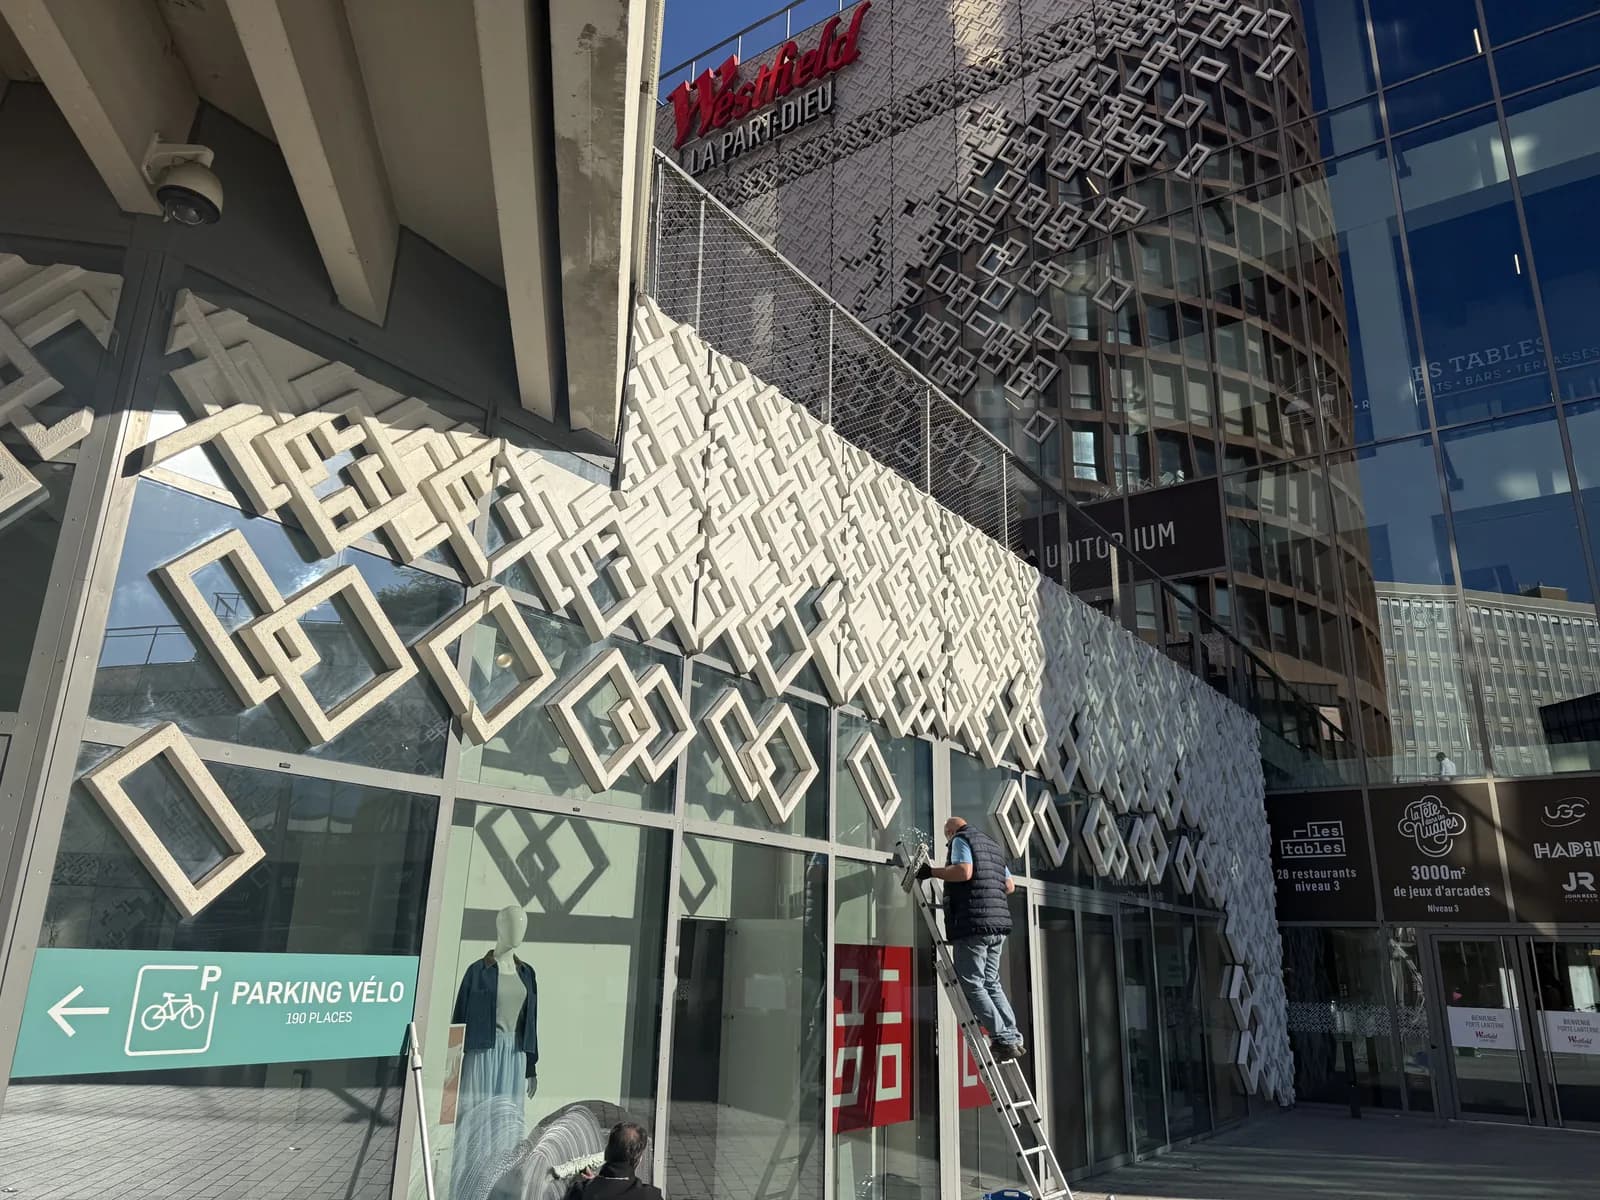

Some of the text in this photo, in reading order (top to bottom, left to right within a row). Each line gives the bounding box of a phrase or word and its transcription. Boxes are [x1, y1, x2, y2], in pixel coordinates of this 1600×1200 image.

[666, 1, 872, 150] Westfield
[690, 80, 834, 176] LA PART-DIEU
[1449, 336, 1545, 373] TABLES
[1464, 346, 1600, 386] BARS TERASSES
[1028, 521, 1176, 568] UDITOIUM
[1545, 803, 1586, 819] UGC
[1311, 825, 1340, 838] les
[1284, 842, 1342, 855] tables
[1276, 867, 1357, 880] 28 restaurants
[1562, 871, 1597, 892] JR
[1295, 881, 1341, 892] niveau 3
[1393, 884, 1491, 900] de jeux d'arcades
[1427, 904, 1460, 913] Niveau 3
[200, 965, 222, 991] P
[231, 974, 404, 1005] PARKING VÉLO
[285, 1010, 353, 1025] 190 PLACES
